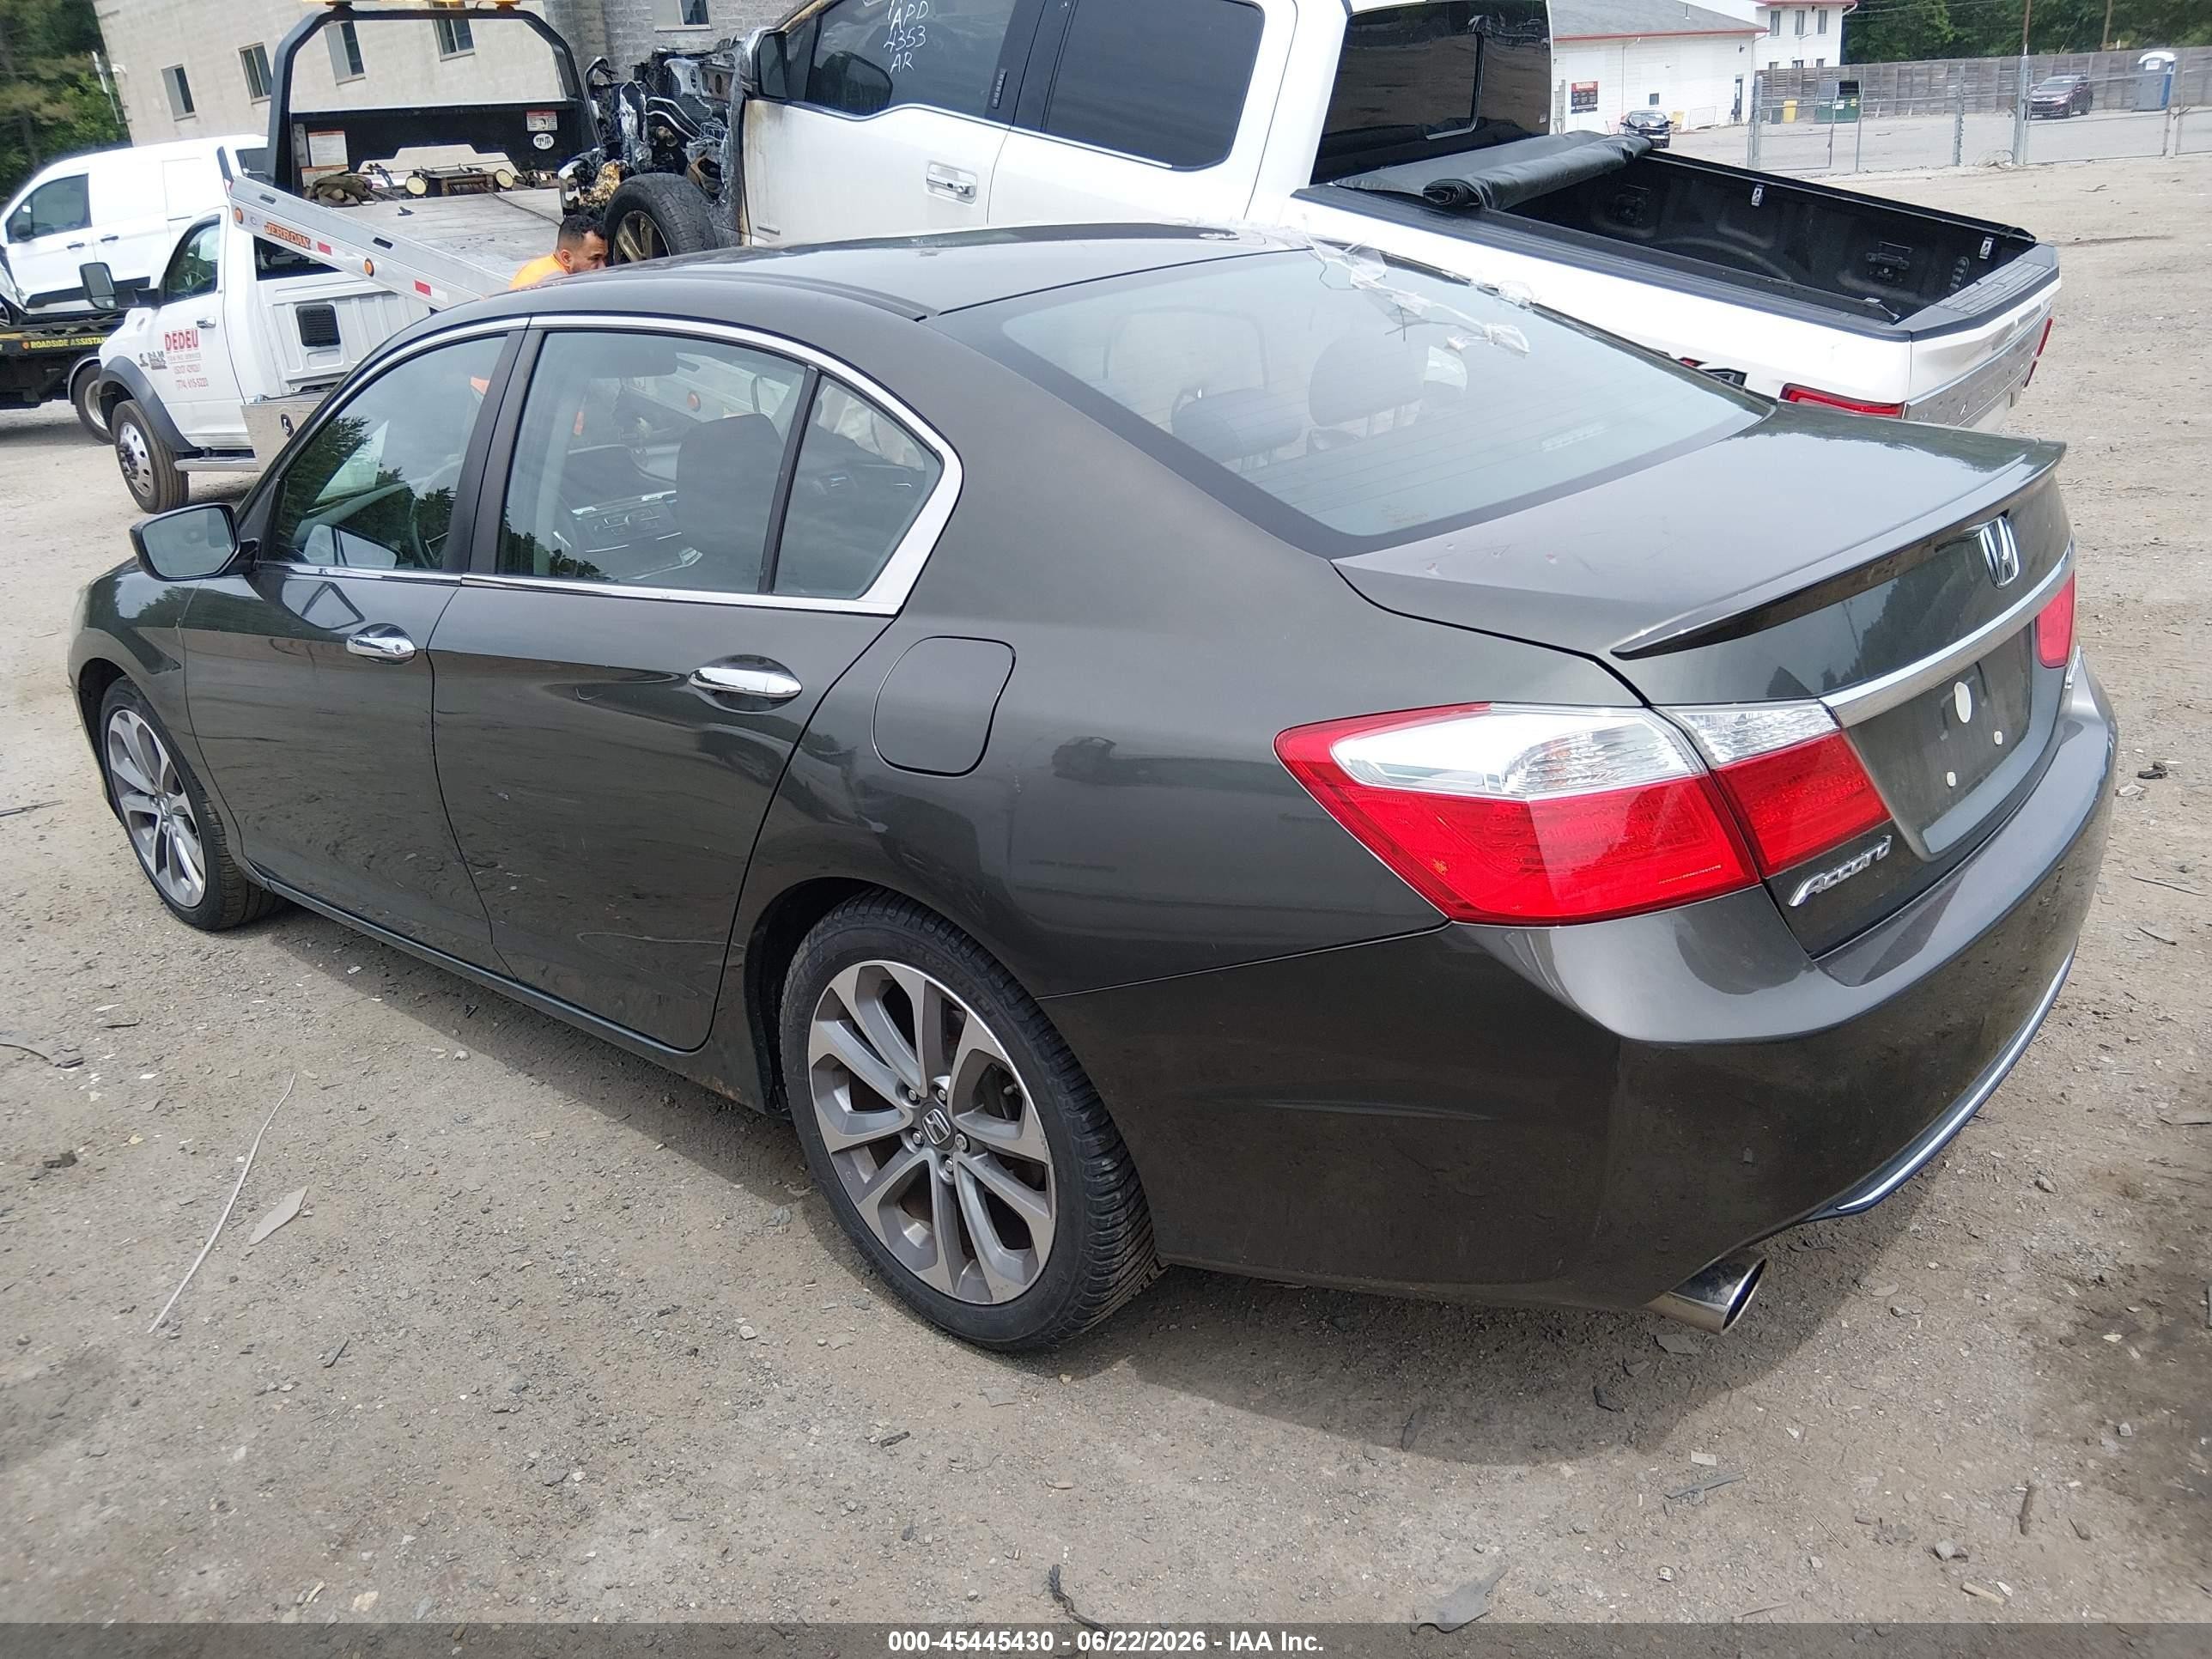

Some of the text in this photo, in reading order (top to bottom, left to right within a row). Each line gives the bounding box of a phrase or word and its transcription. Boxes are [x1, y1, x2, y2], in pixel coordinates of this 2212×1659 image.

[890, 0, 928, 31] APD
[884, 25, 926, 53] 4353
[890, 52, 914, 74] AR
[30, 339, 69, 349] ROADSIDE
[164, 329, 198, 351] DEDEU
[1788, 835, 1893, 907] Accord
